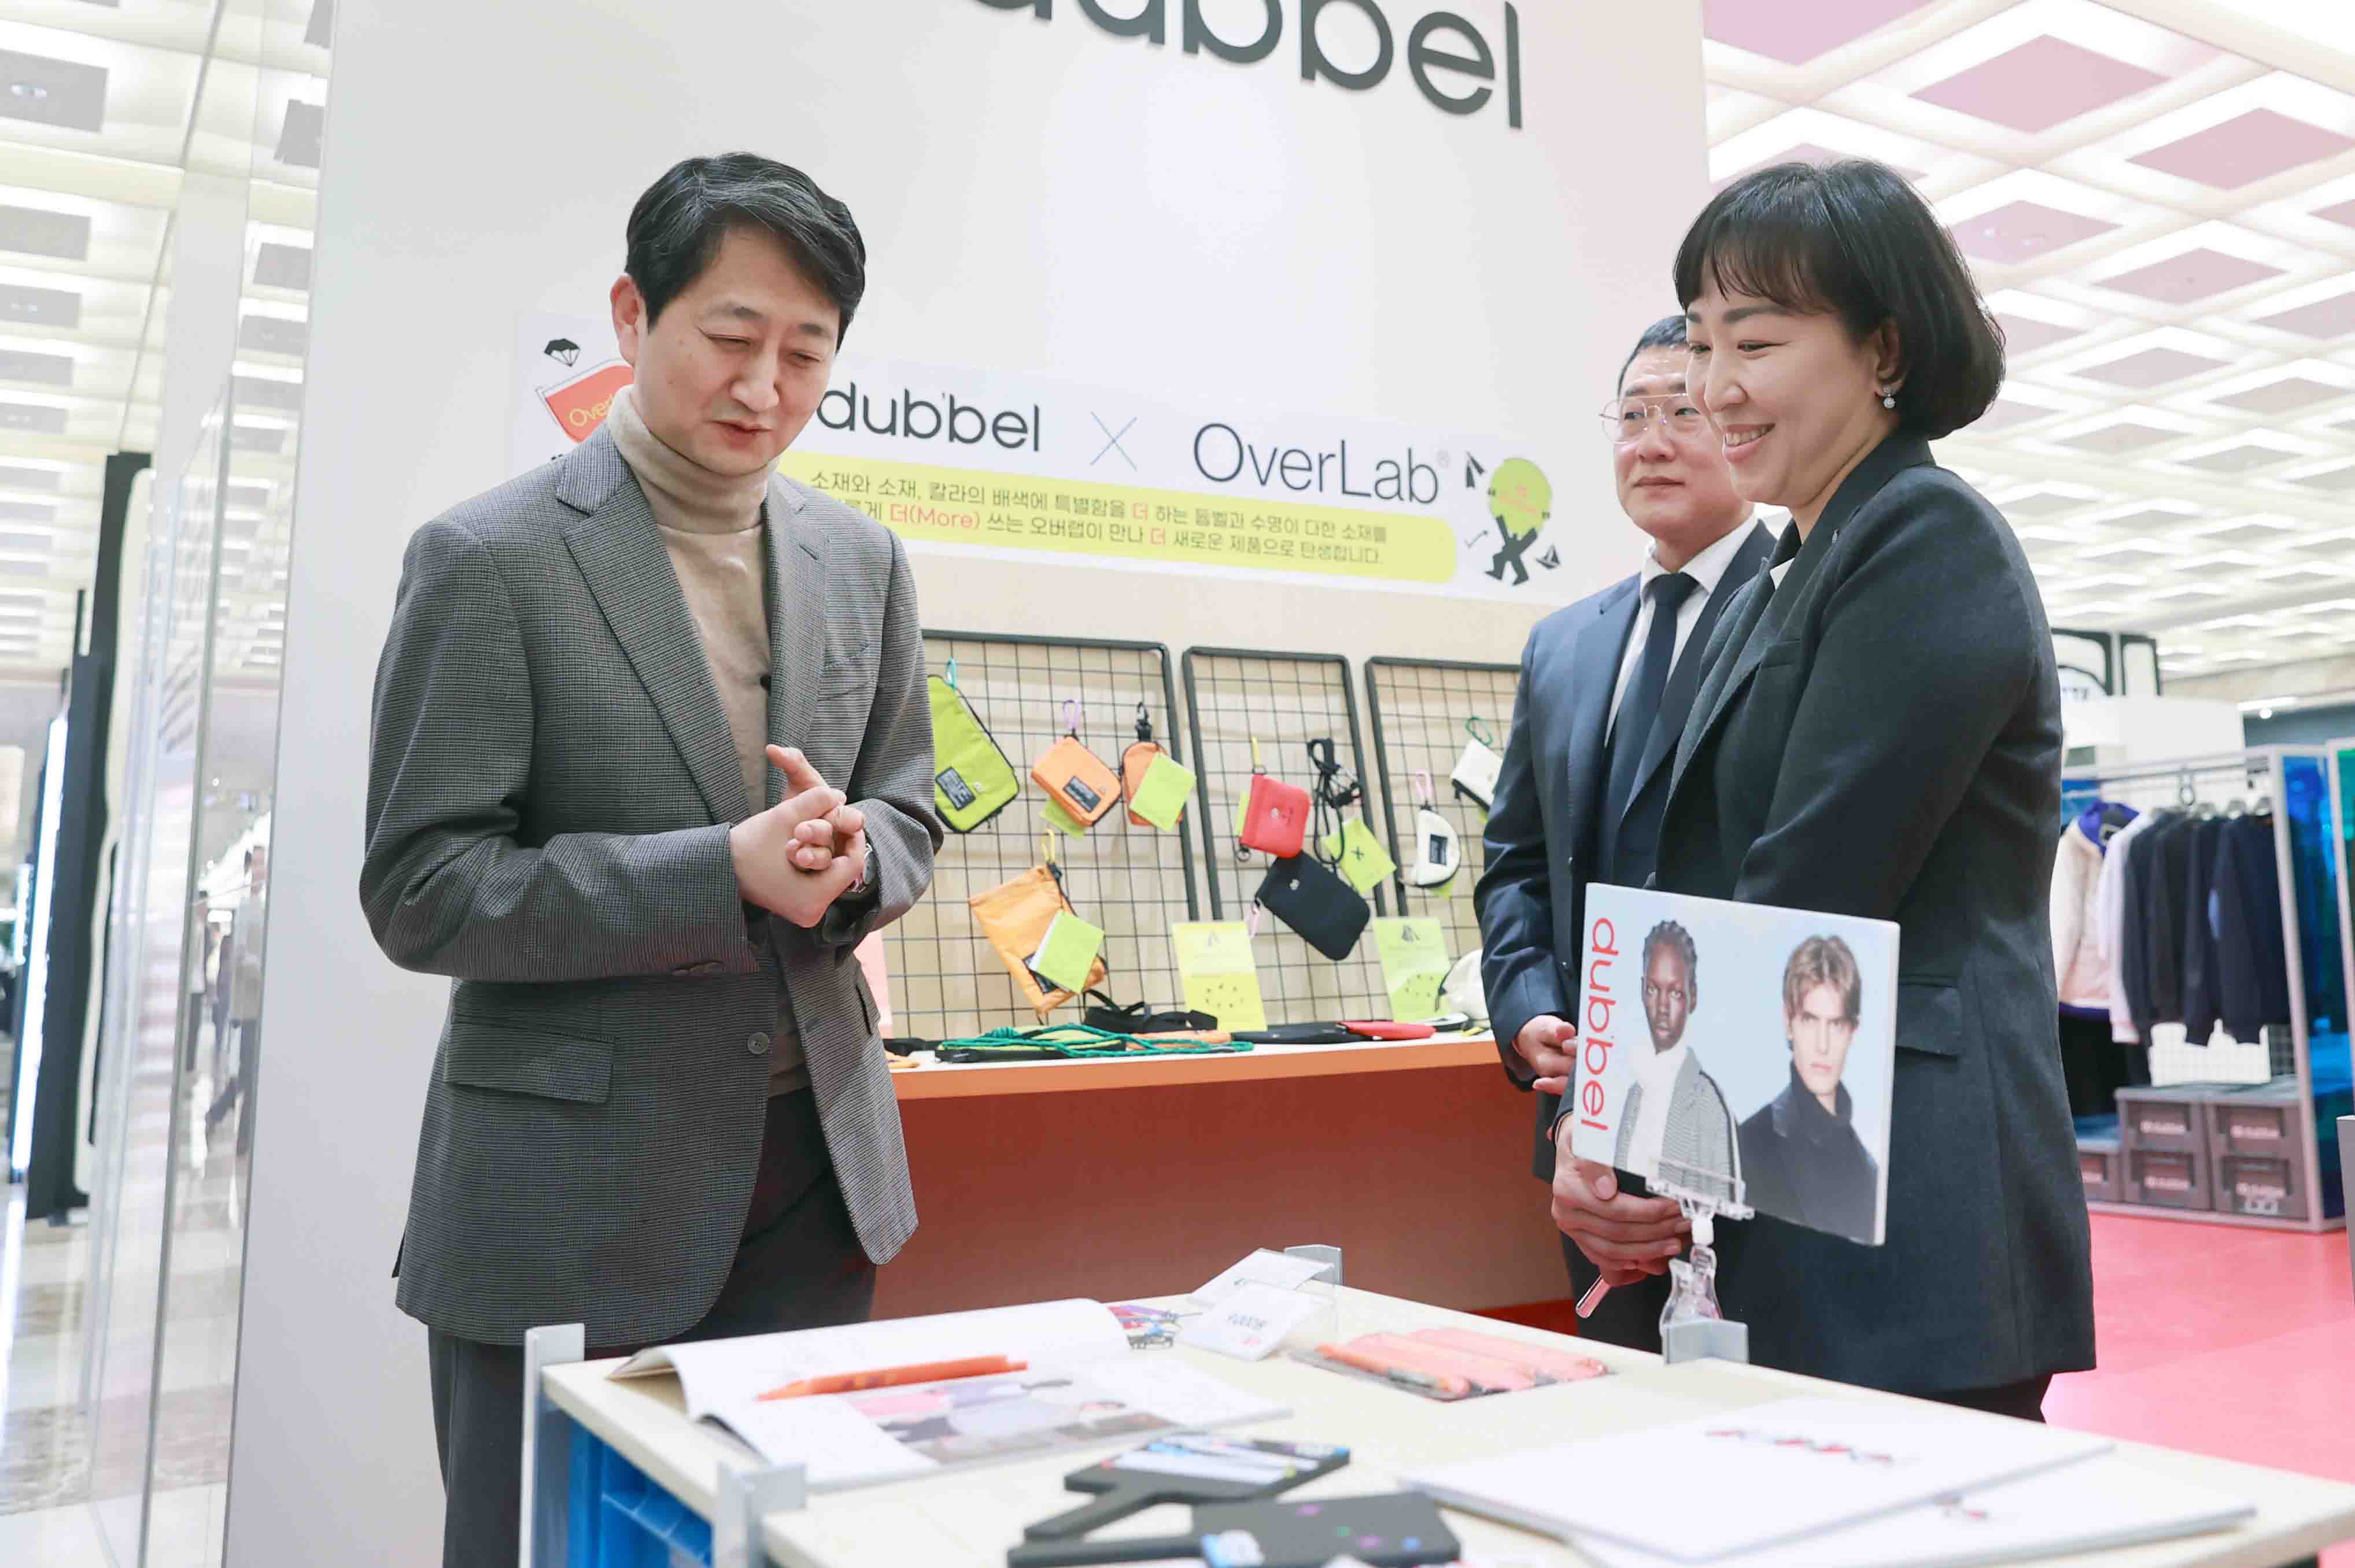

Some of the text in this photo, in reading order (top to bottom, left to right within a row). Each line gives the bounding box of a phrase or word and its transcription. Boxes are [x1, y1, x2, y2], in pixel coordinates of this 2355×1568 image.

[975, 0, 1522, 130] bbel
[811, 471, 870, 494] 소재와
[992, 489, 1048, 512] 배색에
[1132, 502, 1149, 522] 더
[1156, 505, 1188, 526] 하는
[1250, 513, 1300, 536] 수명이
[987, 512, 1024, 533] 쓰는
[1109, 523, 1143, 544] 만나
[1149, 526, 1167, 546] 더
[1174, 530, 1222, 551] 새로운
